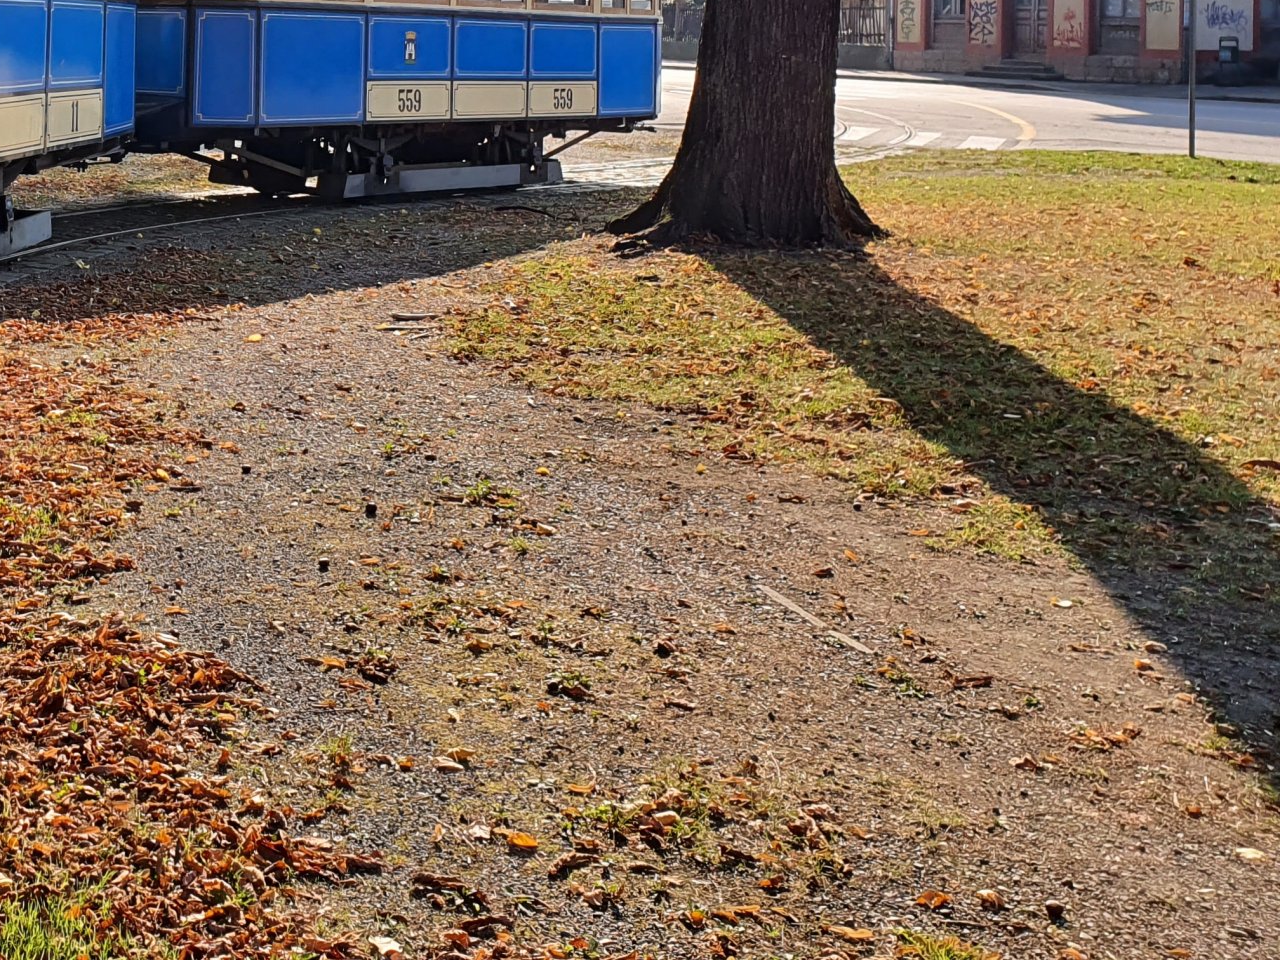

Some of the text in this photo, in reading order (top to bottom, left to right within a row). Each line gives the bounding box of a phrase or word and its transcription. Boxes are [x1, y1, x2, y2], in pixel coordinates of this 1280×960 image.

[397, 88, 422, 113] 559
[553, 88, 573, 110] 559
[71, 100, 79, 133] 11
